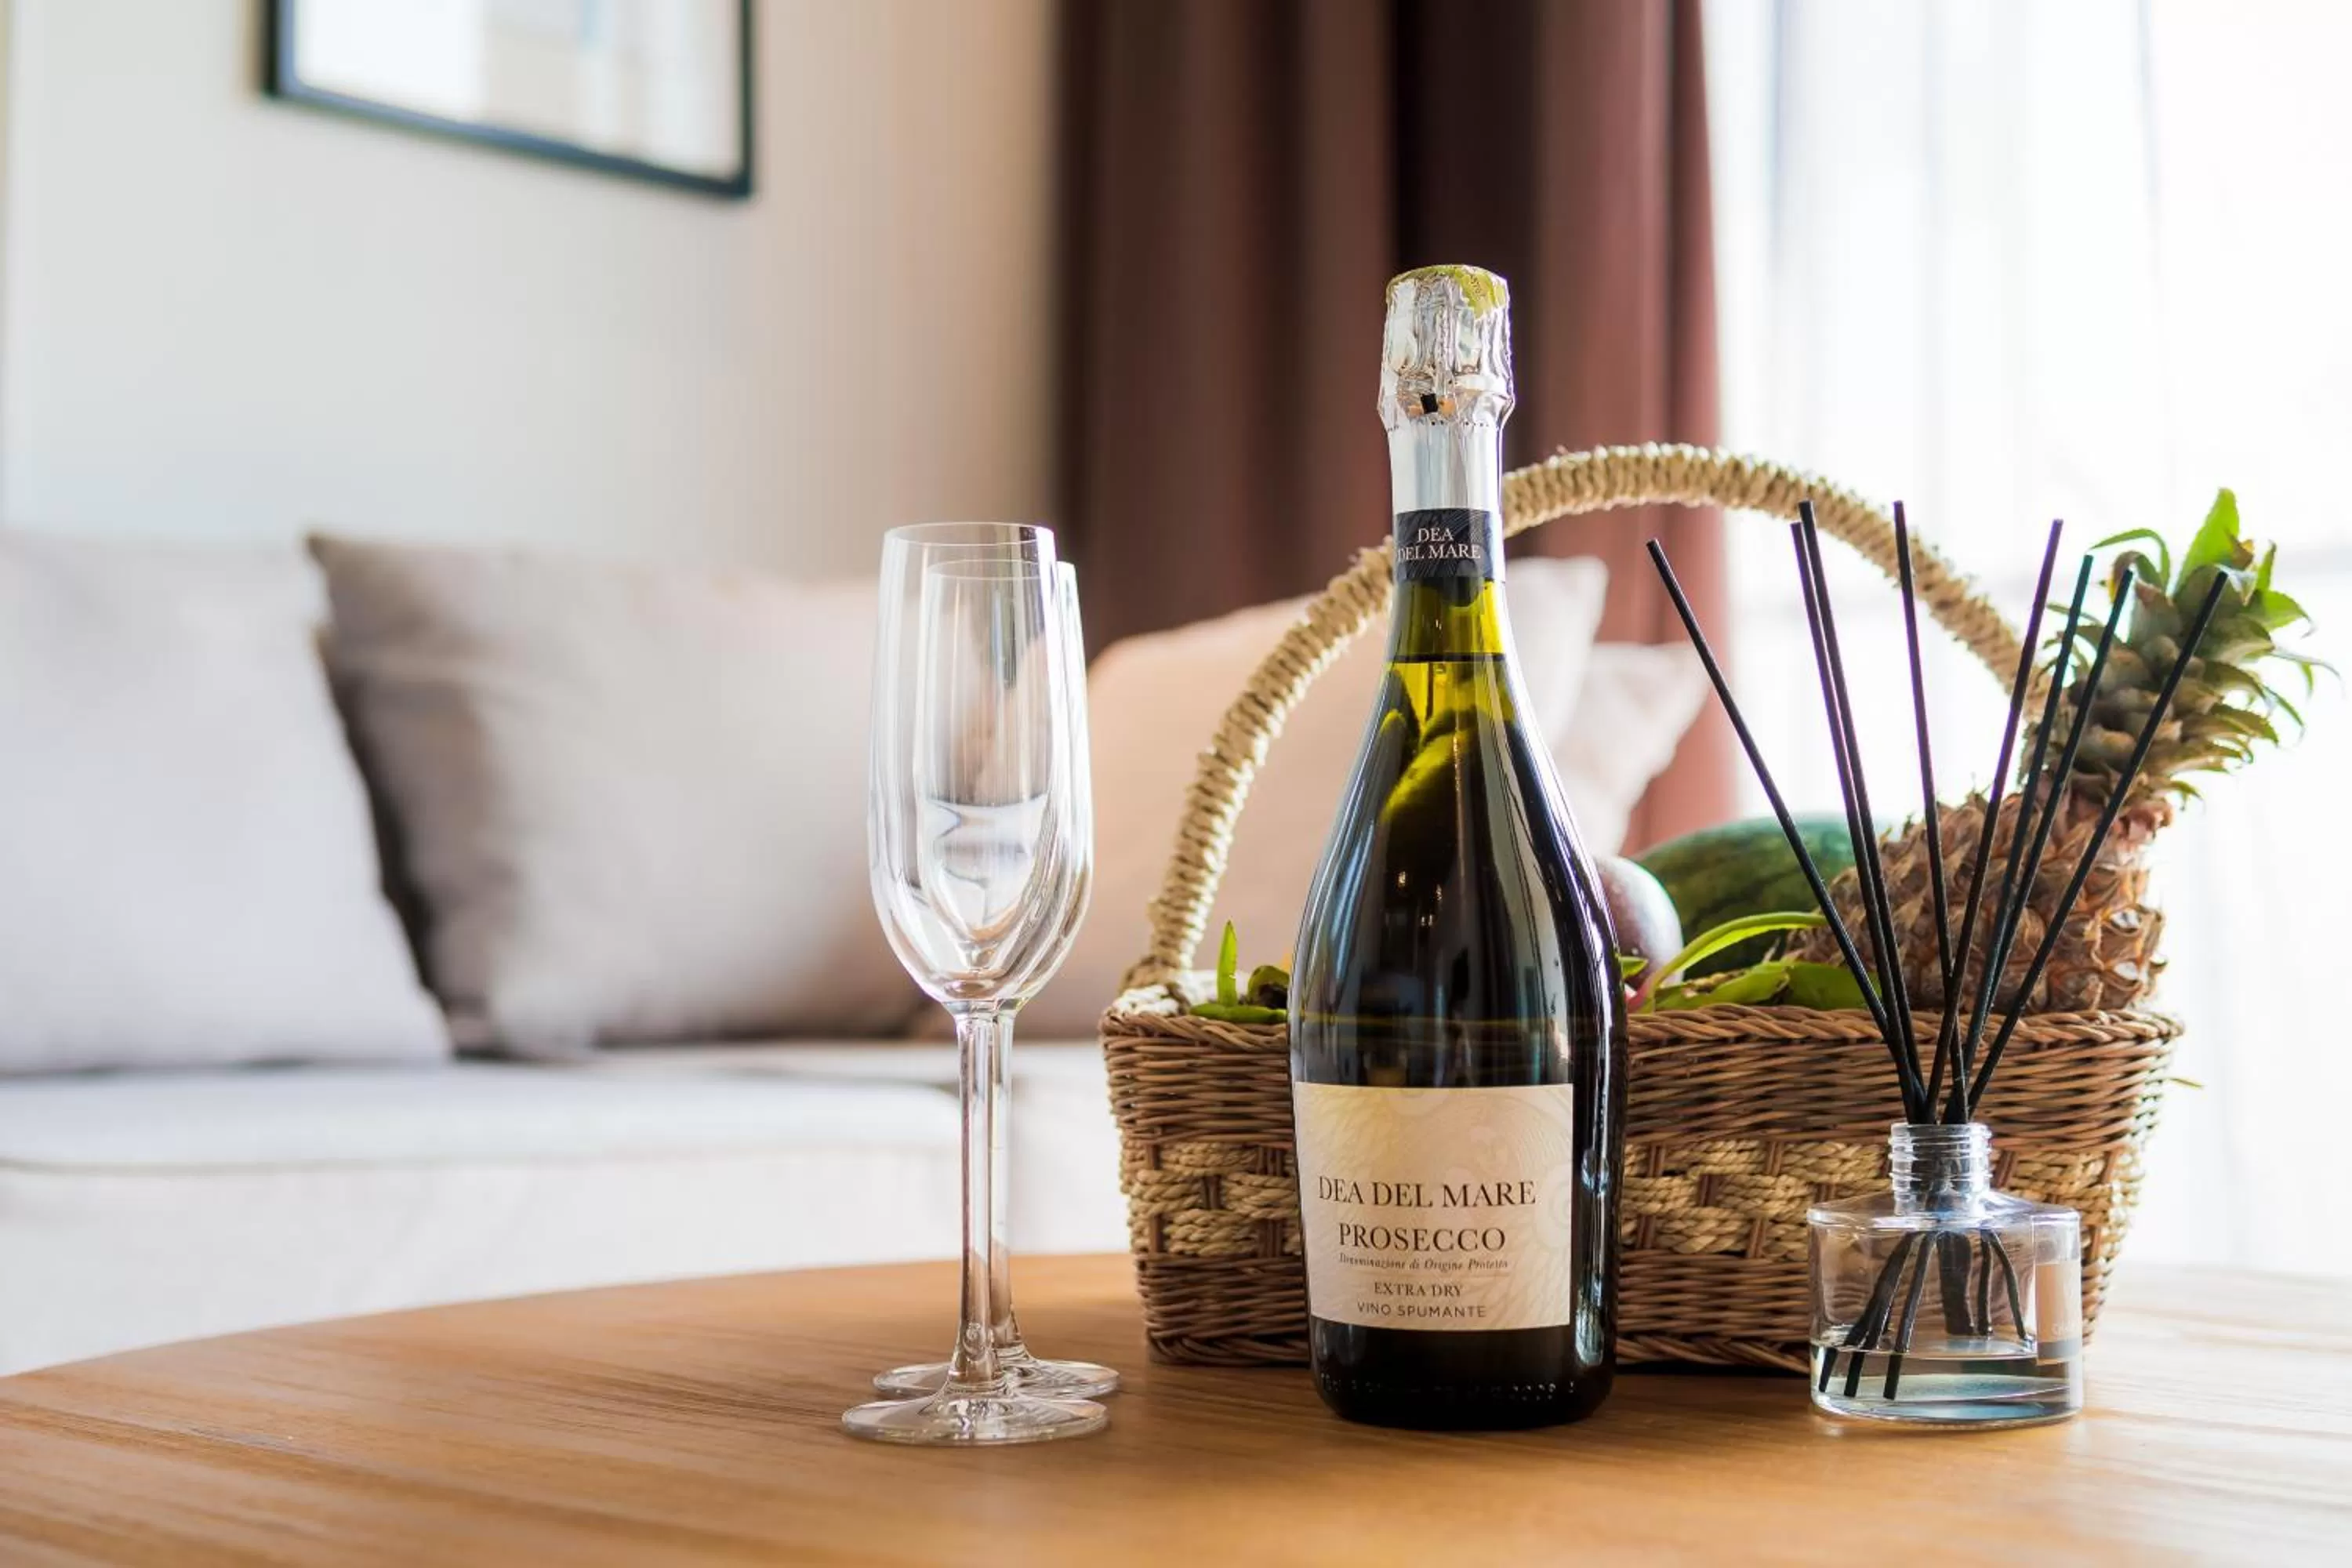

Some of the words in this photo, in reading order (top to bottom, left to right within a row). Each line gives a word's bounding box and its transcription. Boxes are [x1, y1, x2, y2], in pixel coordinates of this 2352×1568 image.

[1417, 528, 1454, 543] DEA
[1398, 544, 1424, 562] DEL
[1428, 543, 1480, 559] MARE
[1319, 1176, 1364, 1204] DEA
[1372, 1181, 1433, 1208] DEL
[1443, 1180, 1537, 1208] MARE
[1339, 1222, 1506, 1252] PROSECCO
[1409, 1258, 1420, 1270] di
[1424, 1258, 1462, 1273] Origine
[1374, 1281, 1426, 1297] EXTRA
[1432, 1283, 1464, 1297] DRY
[1357, 1300, 1392, 1316] VINO
[1398, 1305, 1487, 1318] SPUMANTE
